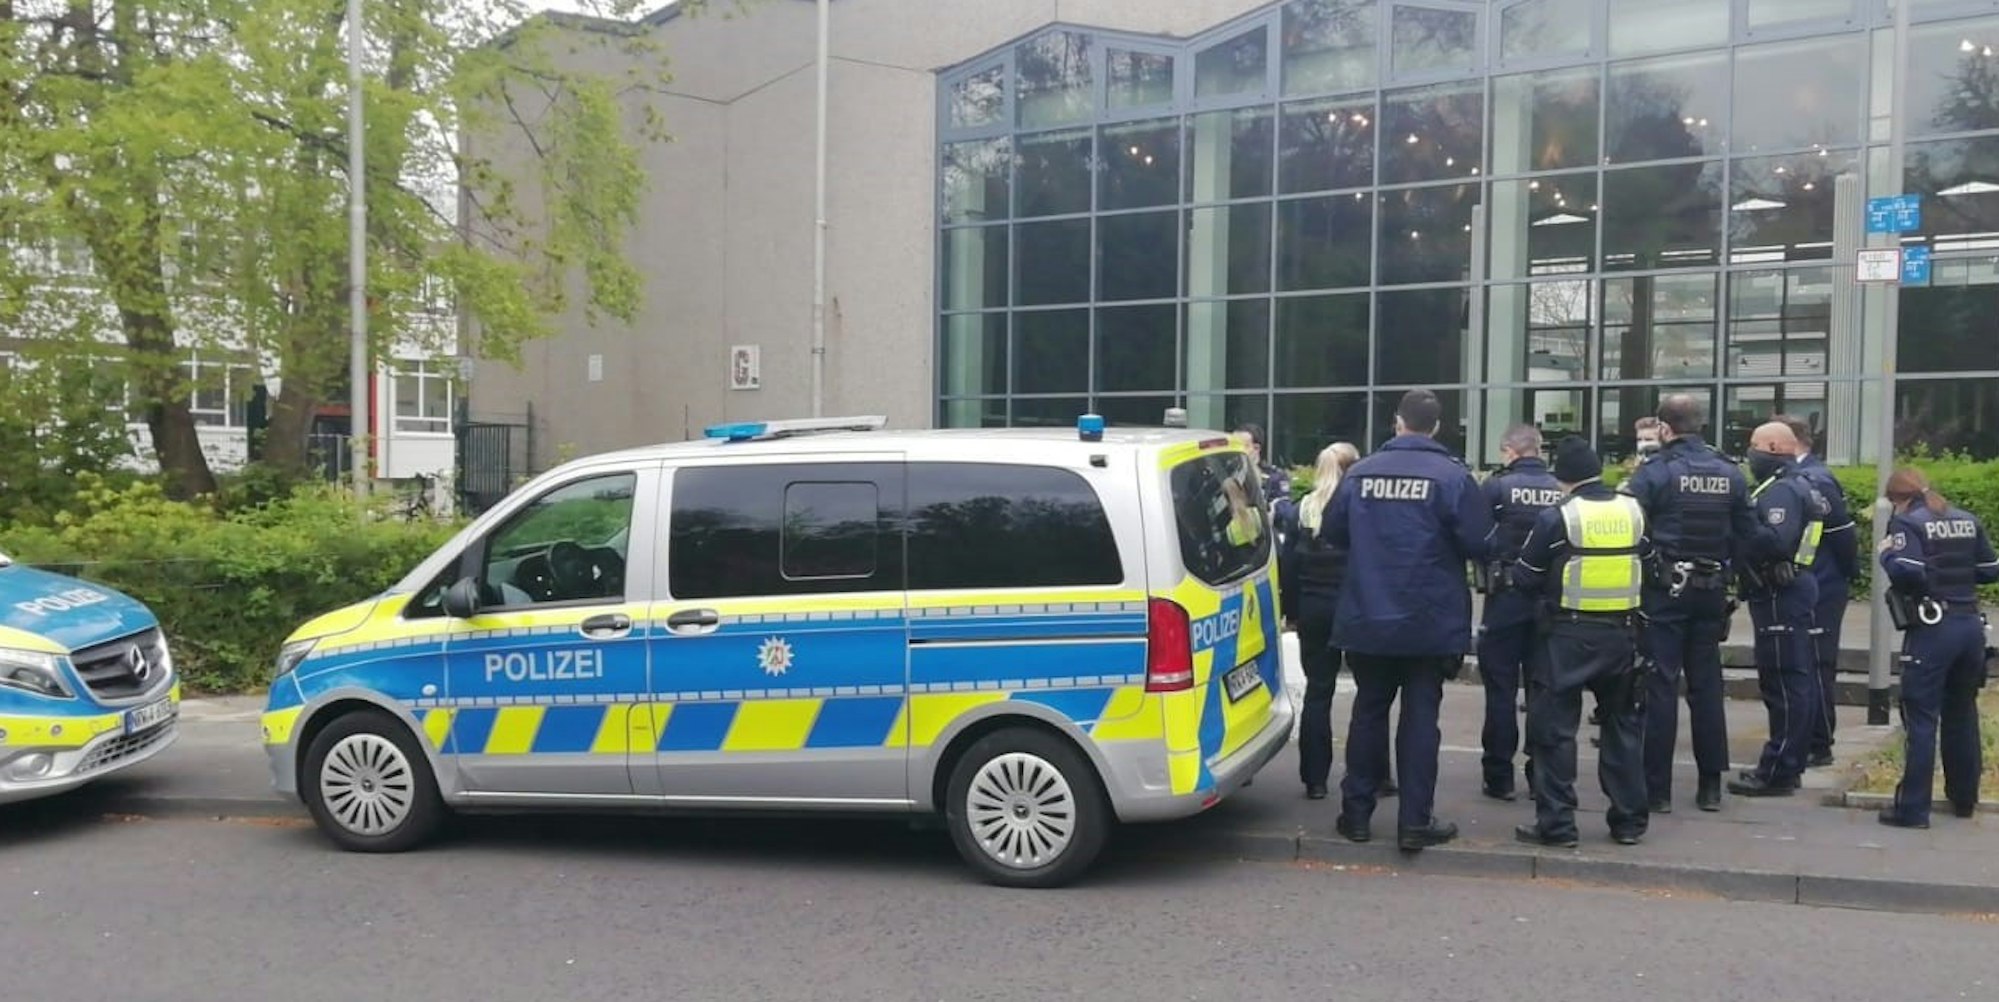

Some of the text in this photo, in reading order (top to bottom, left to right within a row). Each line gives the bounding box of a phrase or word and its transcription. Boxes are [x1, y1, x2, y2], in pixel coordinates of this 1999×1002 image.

[1361, 478, 1430, 500] POLIZEI
[1680, 475, 1731, 494] POLIZEI
[1511, 487, 1565, 506] POLIZE
[1585, 519, 1630, 536] POLIZEI
[1925, 520, 1977, 540] POLIZEI
[15, 588, 109, 616] POLIZEI
[485, 649, 604, 682] POLIZEI
